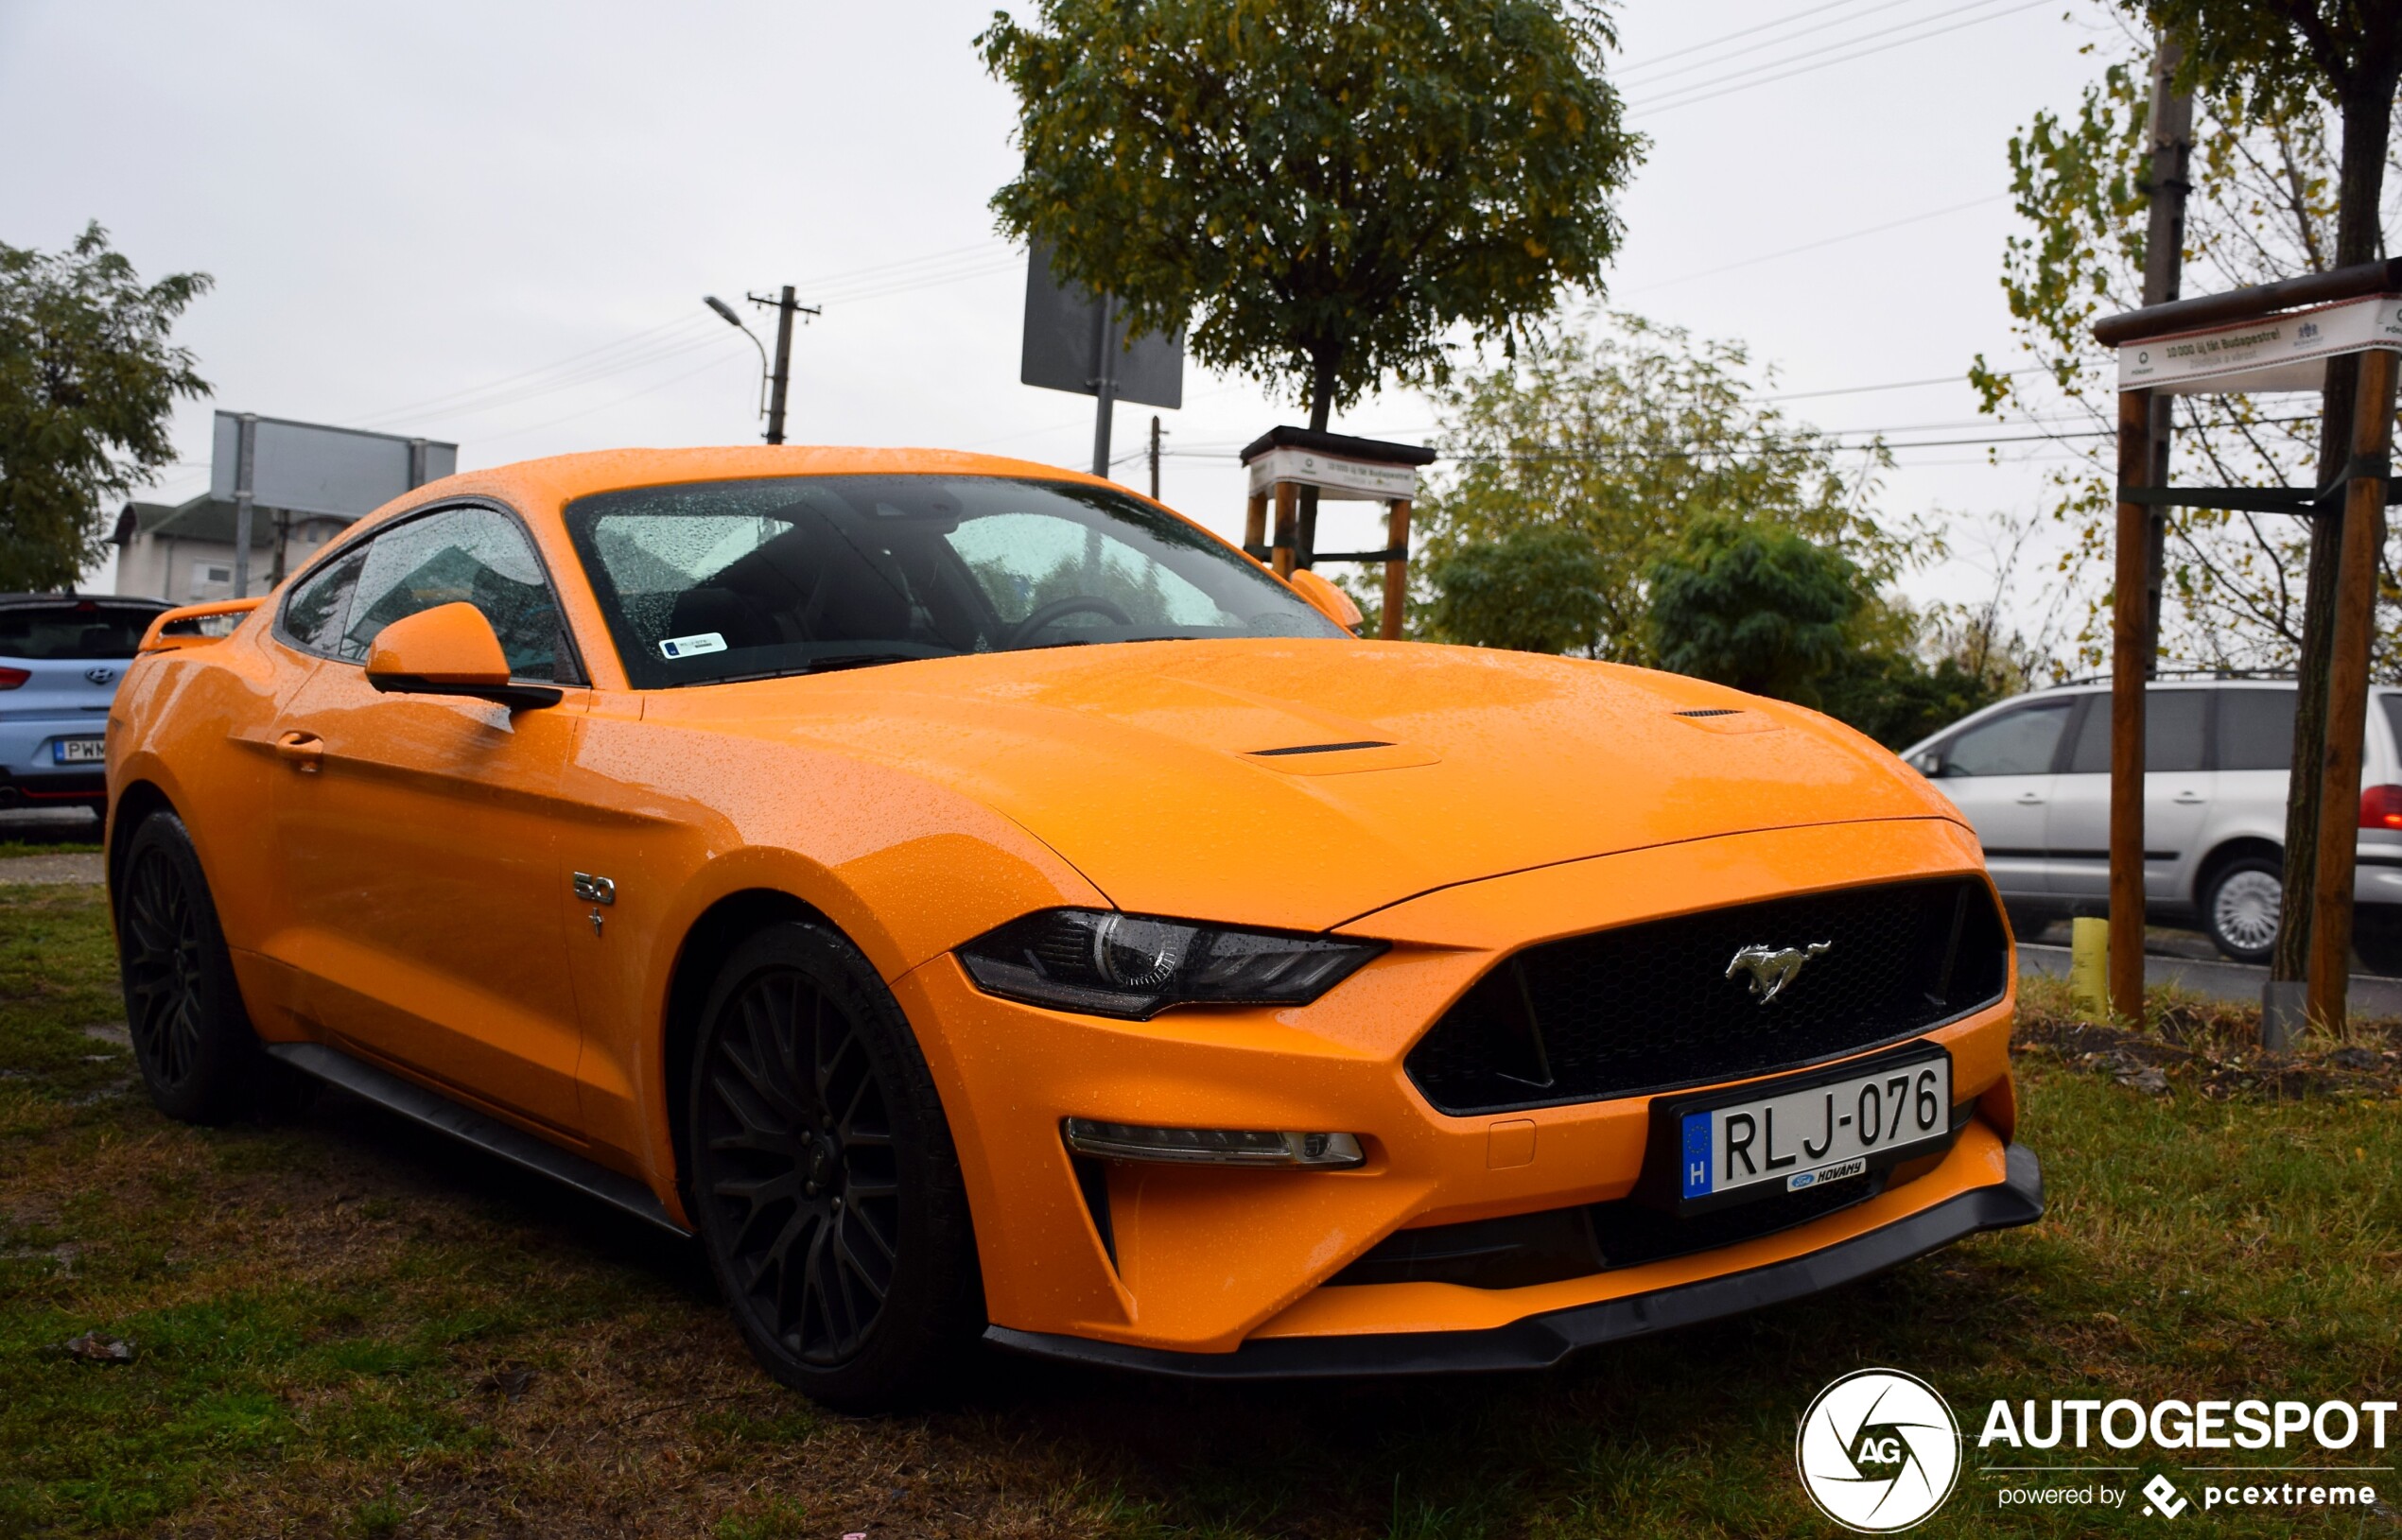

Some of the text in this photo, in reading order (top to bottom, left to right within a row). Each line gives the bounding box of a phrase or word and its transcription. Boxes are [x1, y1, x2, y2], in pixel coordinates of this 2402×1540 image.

[2221, 327, 2281, 349] Budapestre!
[1725, 1068, 1938, 1180] RLJ-076
[1690, 1161, 1704, 1186] H
